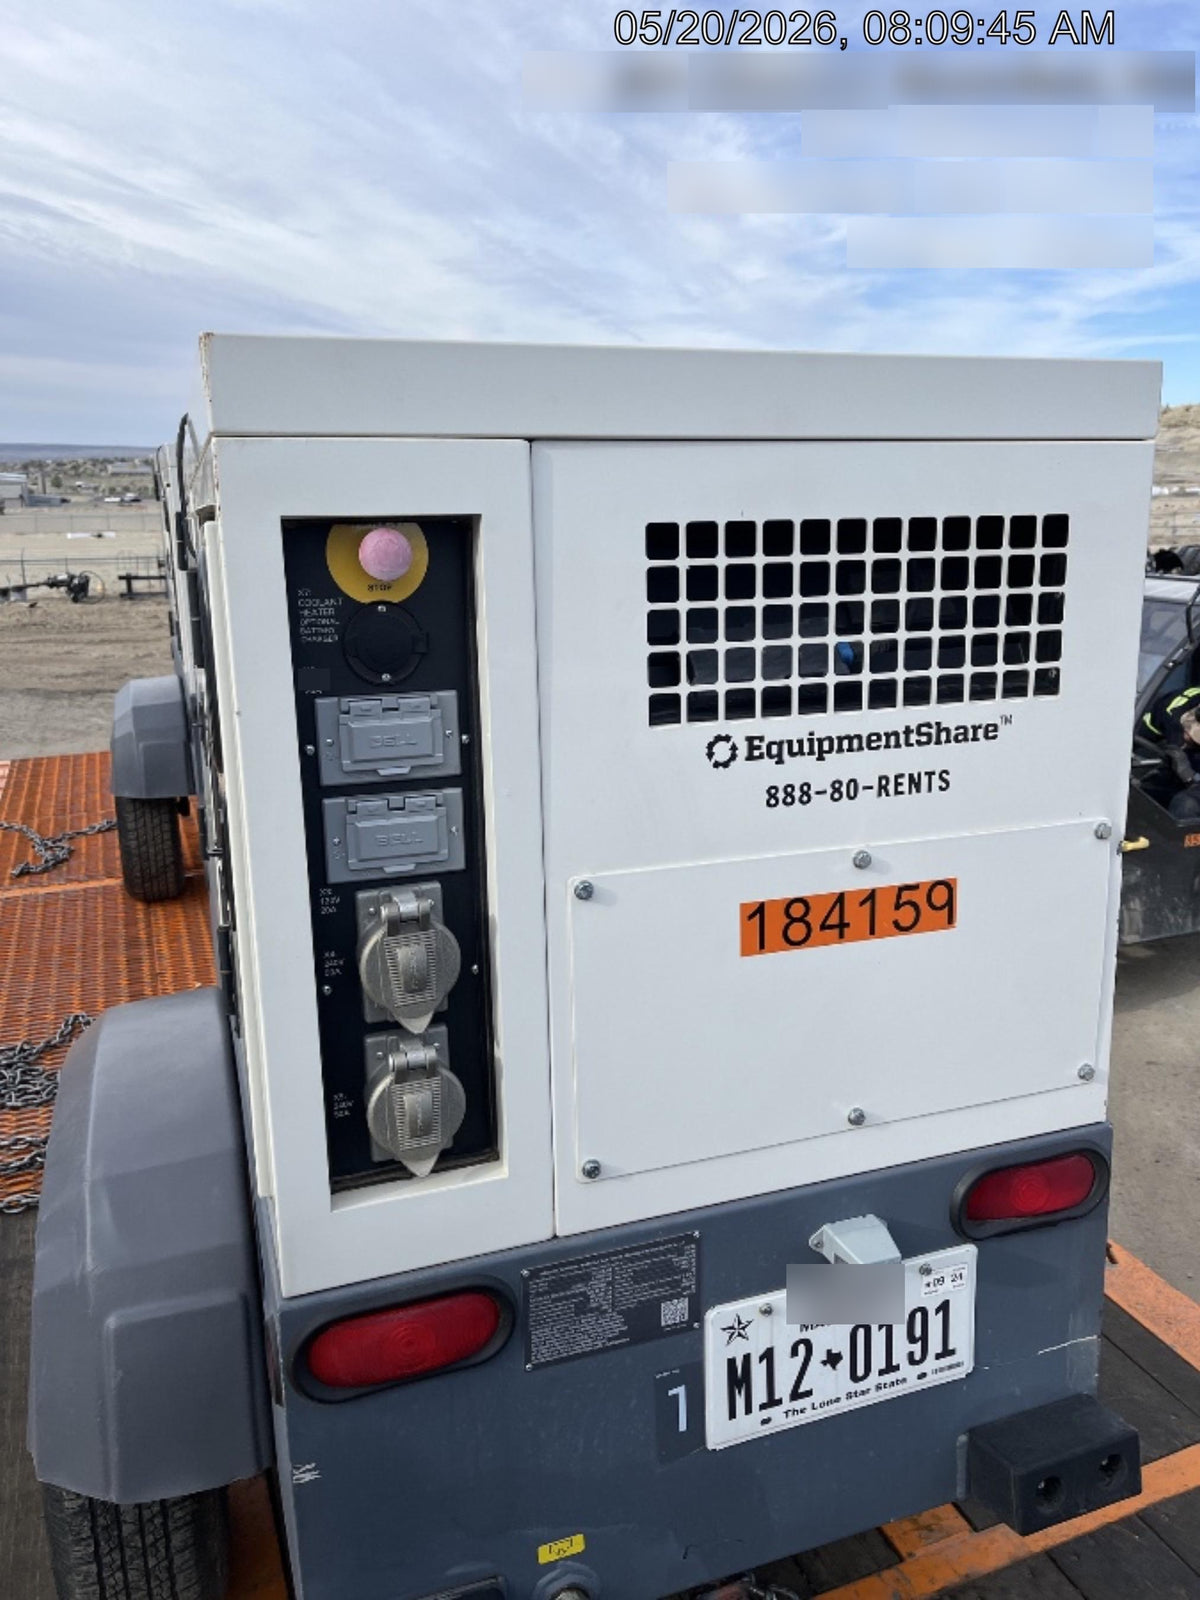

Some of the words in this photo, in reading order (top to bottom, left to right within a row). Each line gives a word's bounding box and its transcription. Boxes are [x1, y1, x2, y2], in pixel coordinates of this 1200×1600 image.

[744, 722, 999, 765] EquipmentShare
[765, 769, 951, 808] 888-80-RENTS
[747, 879, 954, 951] 184159
[783, 1404, 807, 1419] The
[845, 1388, 871, 1401] Star
